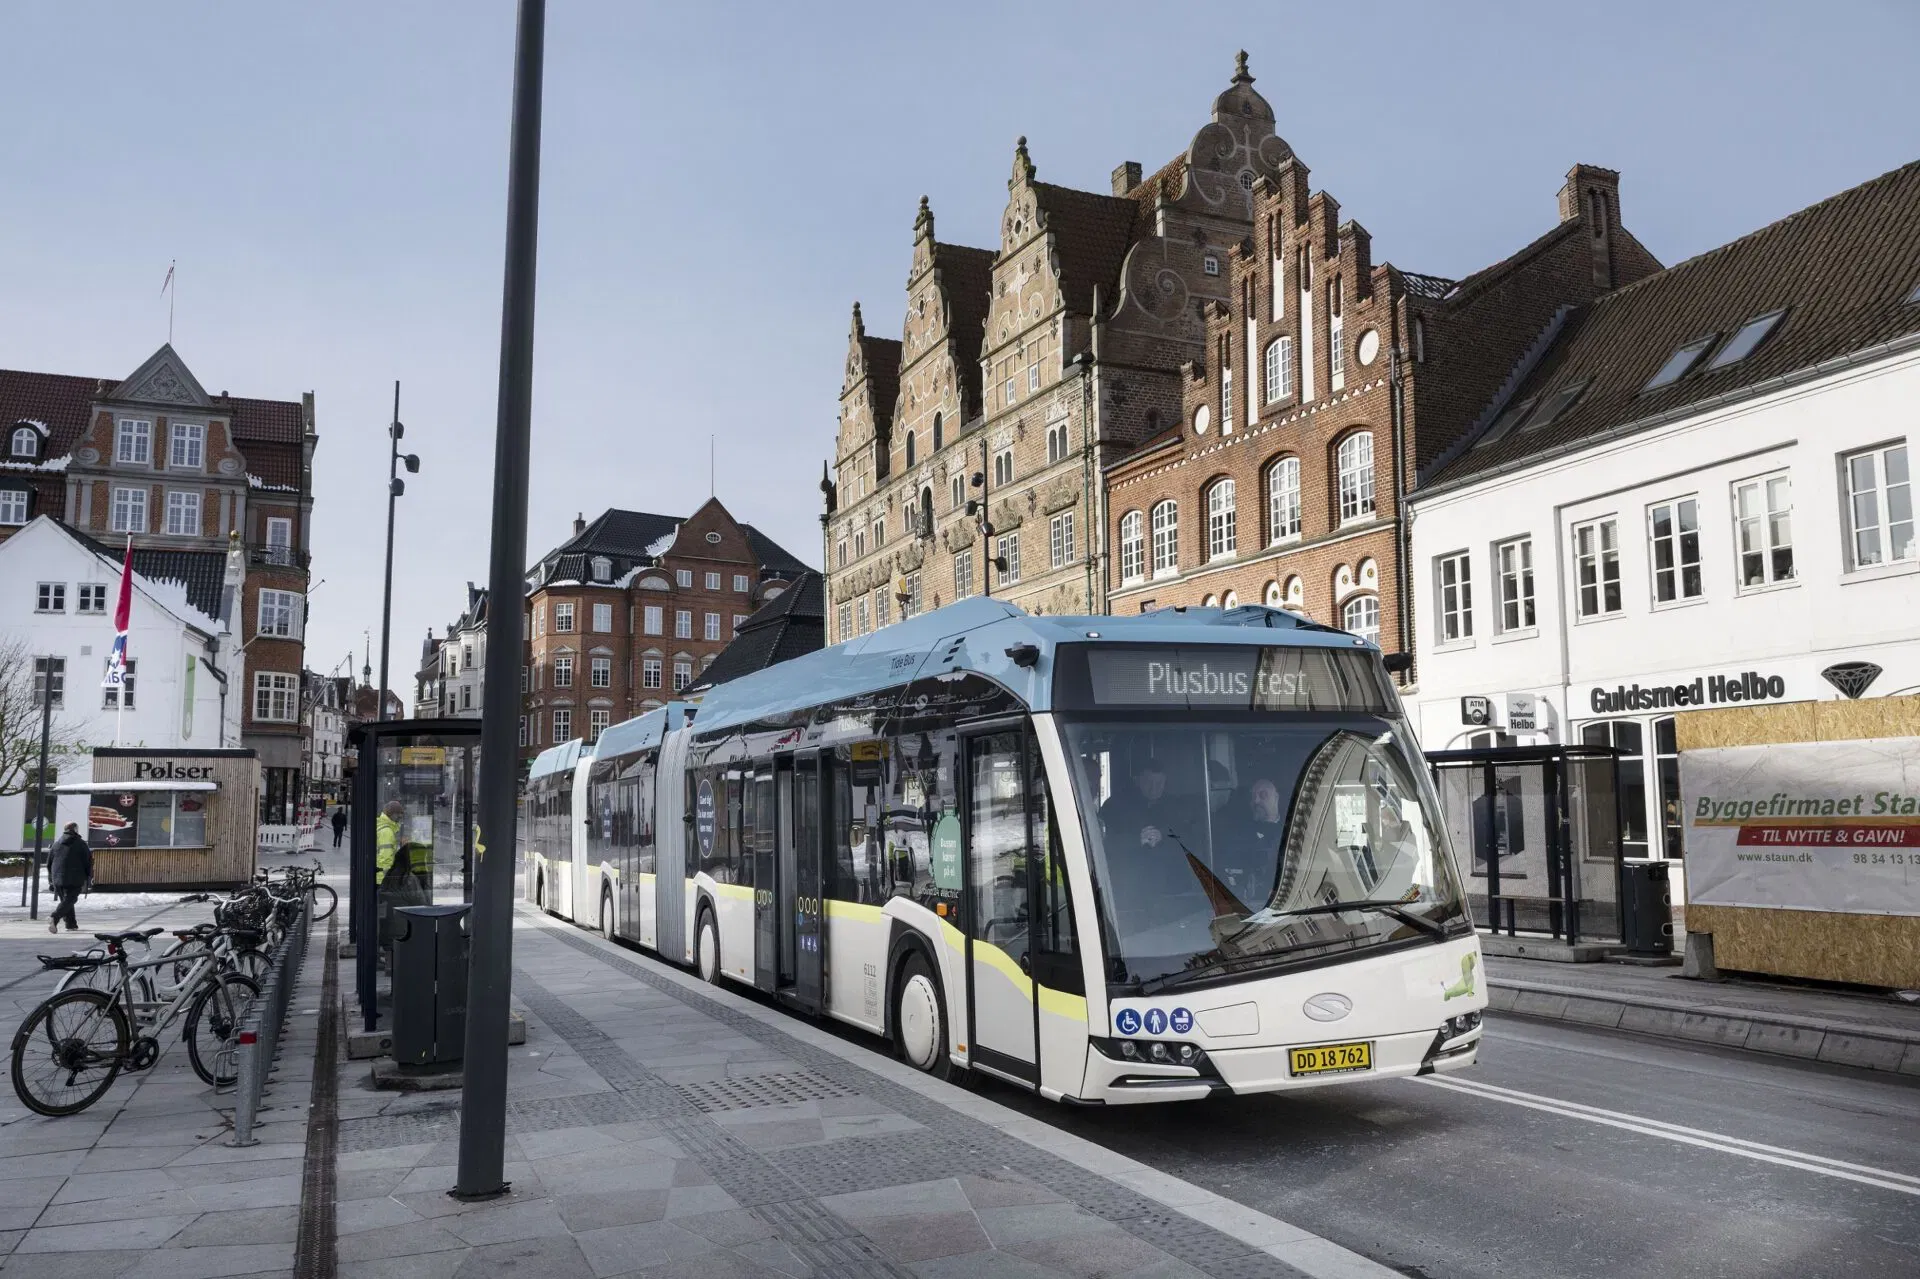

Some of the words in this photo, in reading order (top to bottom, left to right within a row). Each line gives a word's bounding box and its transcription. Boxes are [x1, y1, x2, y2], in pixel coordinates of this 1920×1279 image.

[1148, 662, 1248, 694] Plusbus
[1257, 669, 1308, 695] test
[1590, 677, 1704, 713] Guldsmed
[1708, 671, 1785, 703] Helbo
[1510, 719, 1535, 729] Helbo
[134, 761, 214, 779] Pølser
[1695, 793, 1865, 822] Byggefirmaet
[1871, 791, 1920, 815] Sta
[1762, 829, 1781, 842] TIL
[1785, 829, 1832, 843] NYTTE
[1835, 829, 1848, 843] &
[1852, 829, 1905, 843] GAVN!
[1737, 851, 1813, 863] www.staun.dk
[1853, 853, 1867, 864] 98
[1871, 853, 1886, 864] 34
[1890, 854, 1904, 864] 13
[1908, 854, 1920, 865] 13
[1297, 1053, 1316, 1069] DD
[1320, 1050, 1336, 1067] 18
[1339, 1047, 1364, 1065] 762
